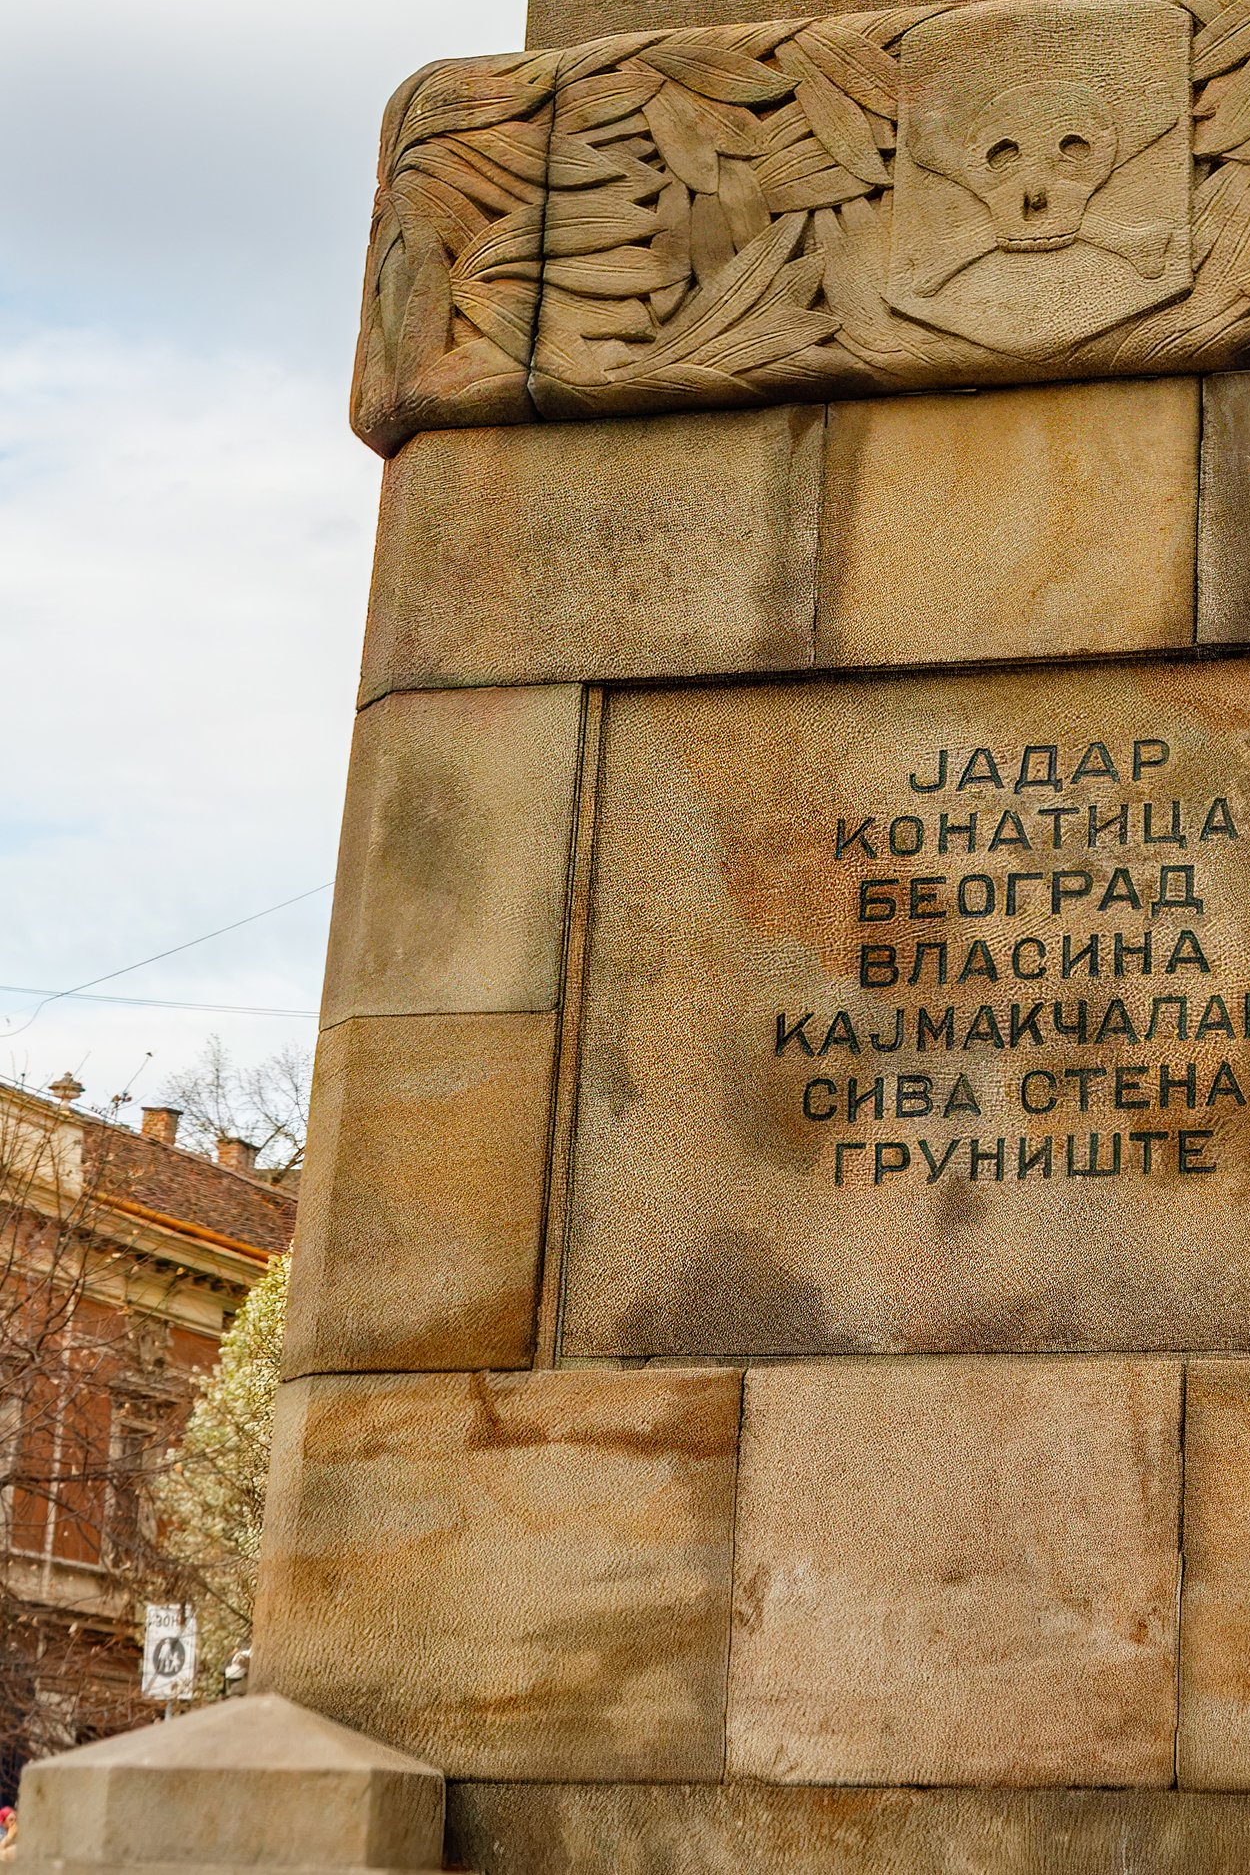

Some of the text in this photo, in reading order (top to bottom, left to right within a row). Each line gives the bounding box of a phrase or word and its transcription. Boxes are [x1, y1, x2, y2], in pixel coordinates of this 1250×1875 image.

[909, 738, 1170, 794] ЈАДАР
[835, 798, 1238, 860] КОНАТИЦА
[859, 864, 1204, 923] БЕОГРАД
[859, 930, 1210, 989] ВЛАСИНА
[802, 1061, 1248, 1123] СИВА СТЕНА
[834, 1129, 1218, 1185] ГРУНИШТЕ
